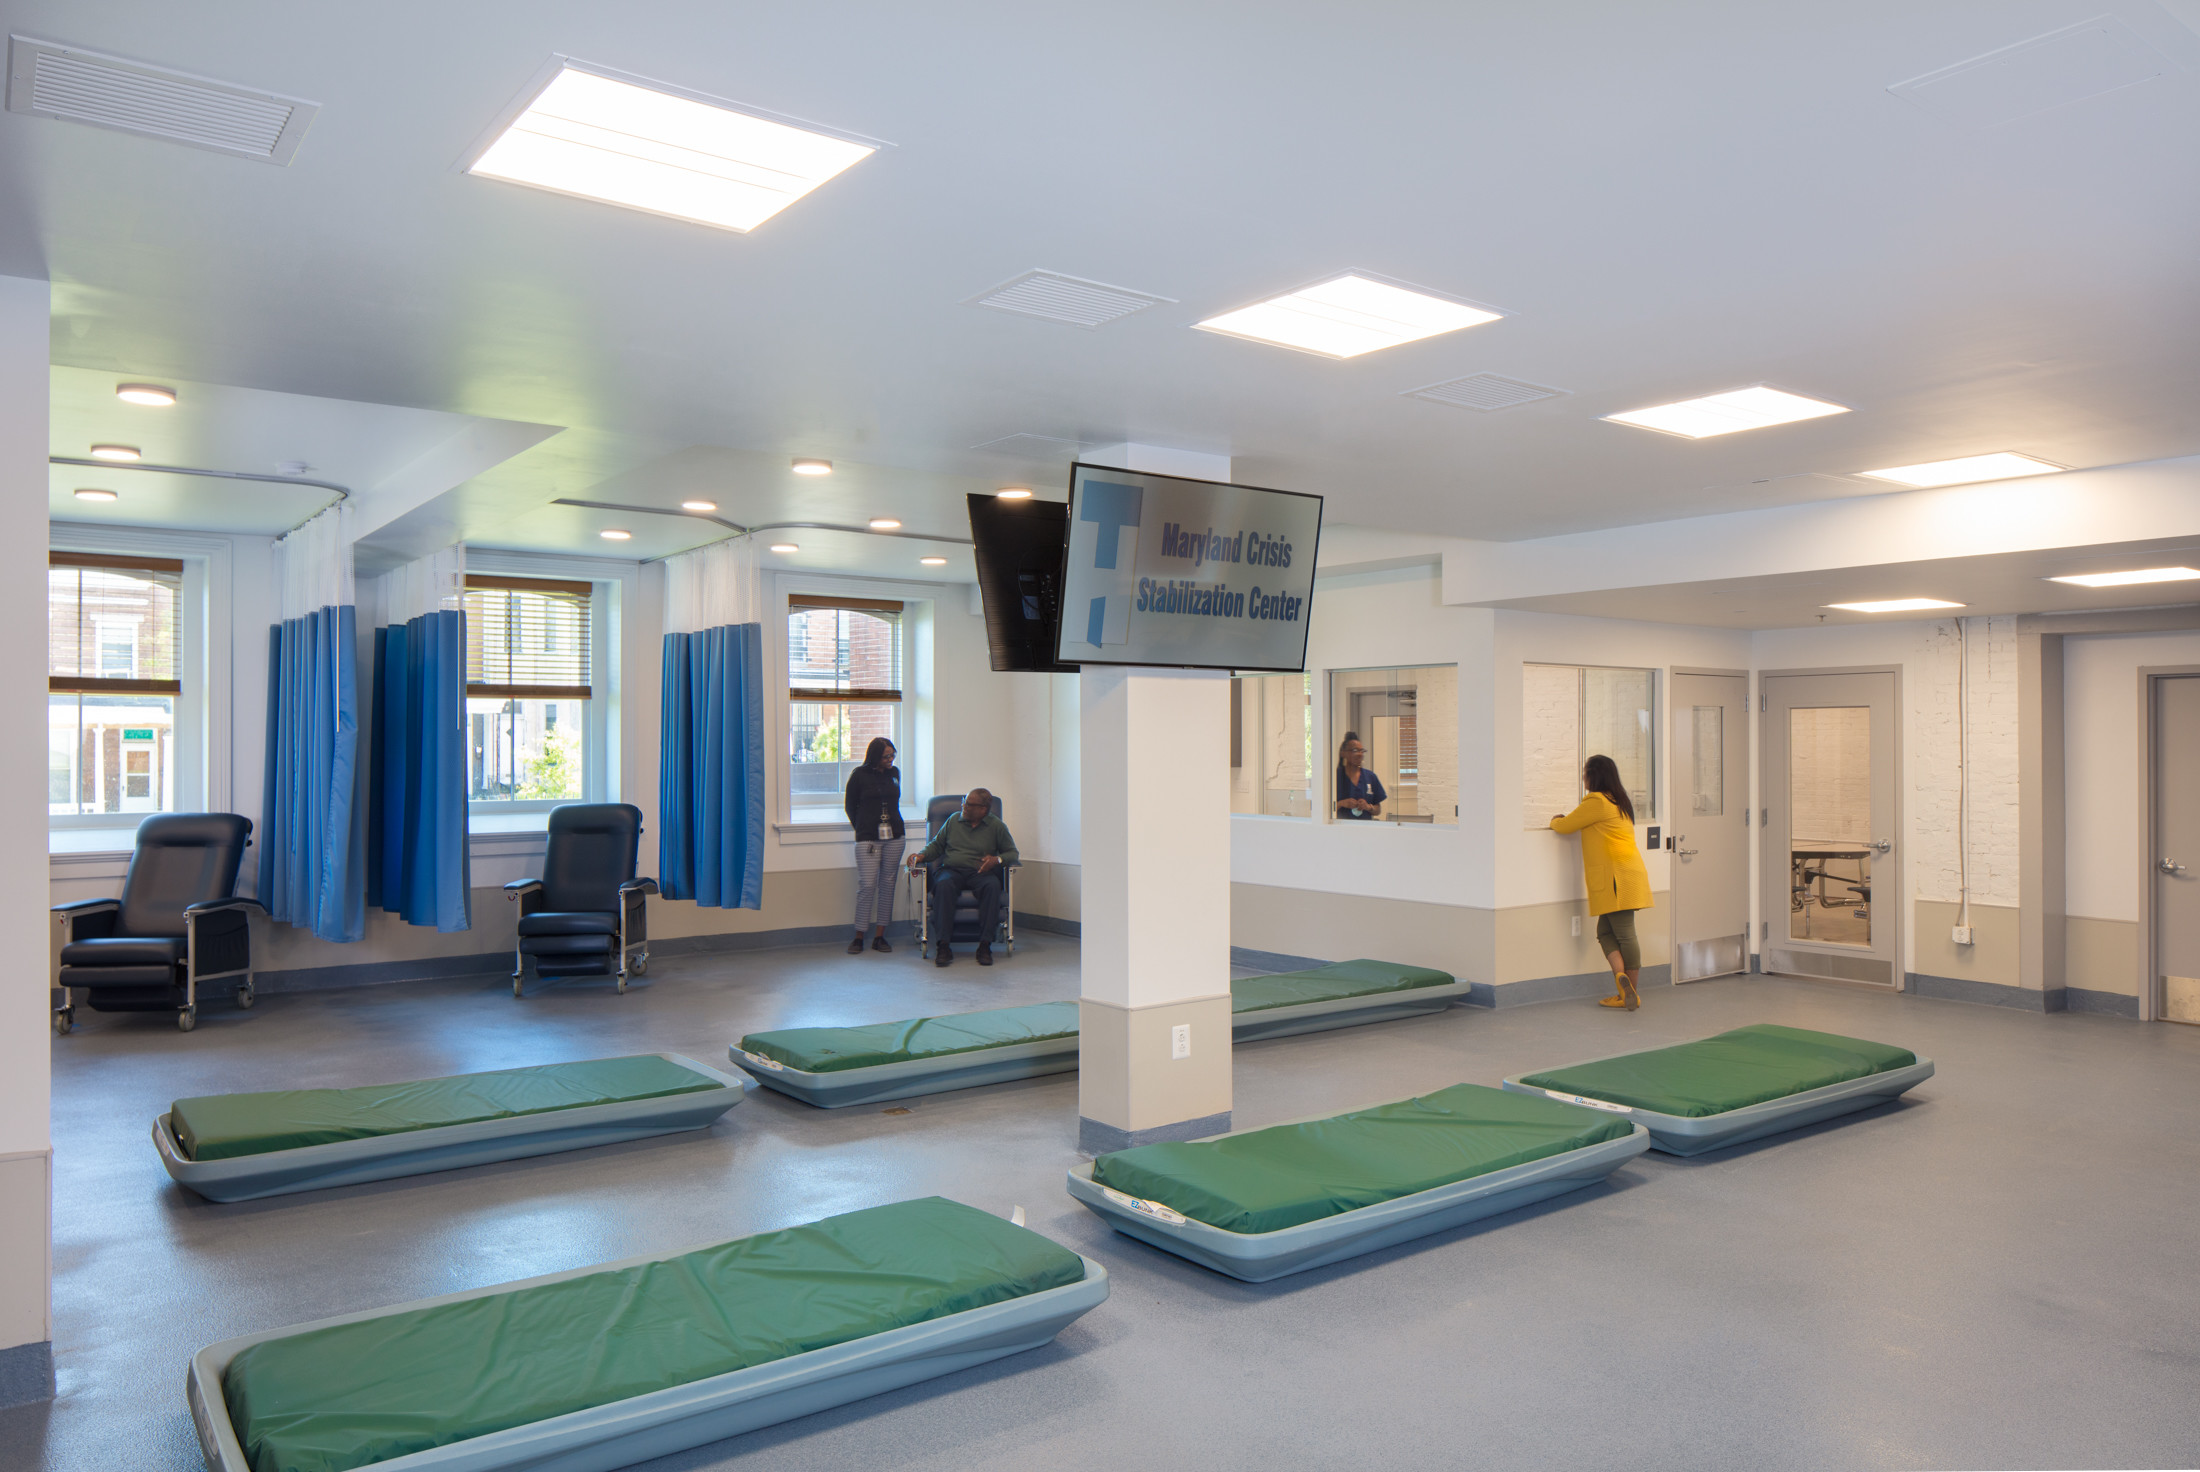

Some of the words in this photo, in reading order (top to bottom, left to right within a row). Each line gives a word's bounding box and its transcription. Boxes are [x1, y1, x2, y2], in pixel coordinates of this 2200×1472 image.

[1162, 522, 1243, 567] Maryland
[1246, 532, 1292, 568] Crisis
[1137, 577, 1243, 617] Stabilization
[1248, 587, 1302, 621] Center
